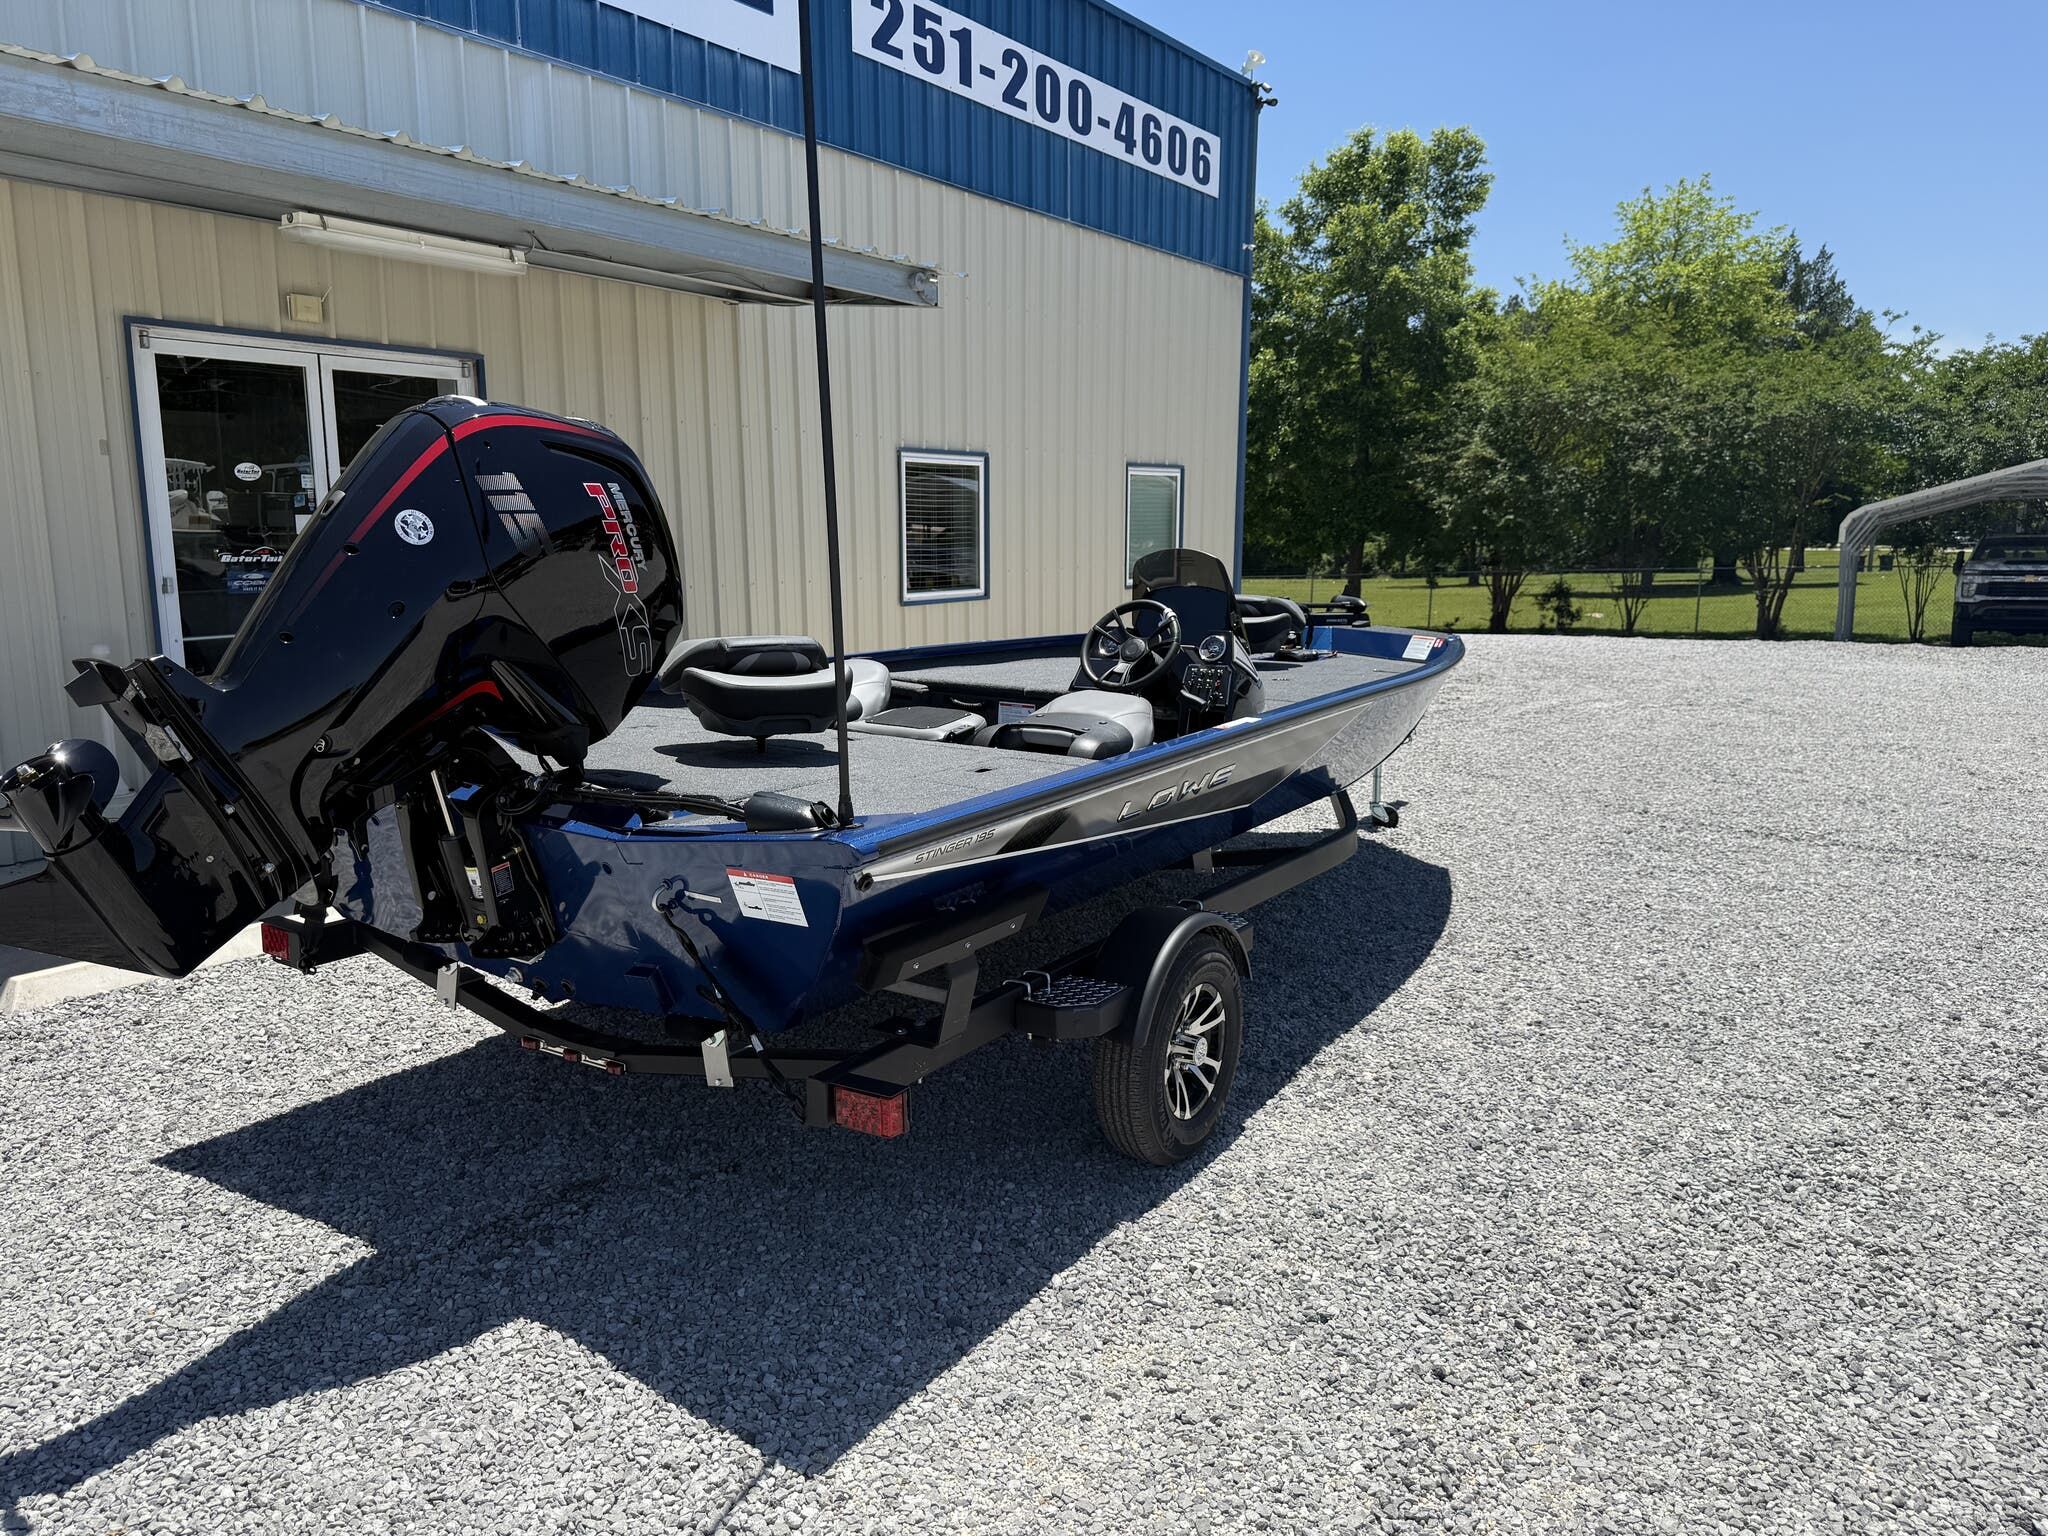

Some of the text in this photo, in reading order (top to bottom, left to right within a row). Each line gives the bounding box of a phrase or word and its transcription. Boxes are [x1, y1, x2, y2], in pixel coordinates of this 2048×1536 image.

[869, 0, 1211, 186] 251-200-4606
[607, 482, 648, 572] MERCURY
[583, 482, 653, 677] PRO XS
[1117, 763, 1237, 823] LOWE
[914, 828, 996, 865] STINGER 195
